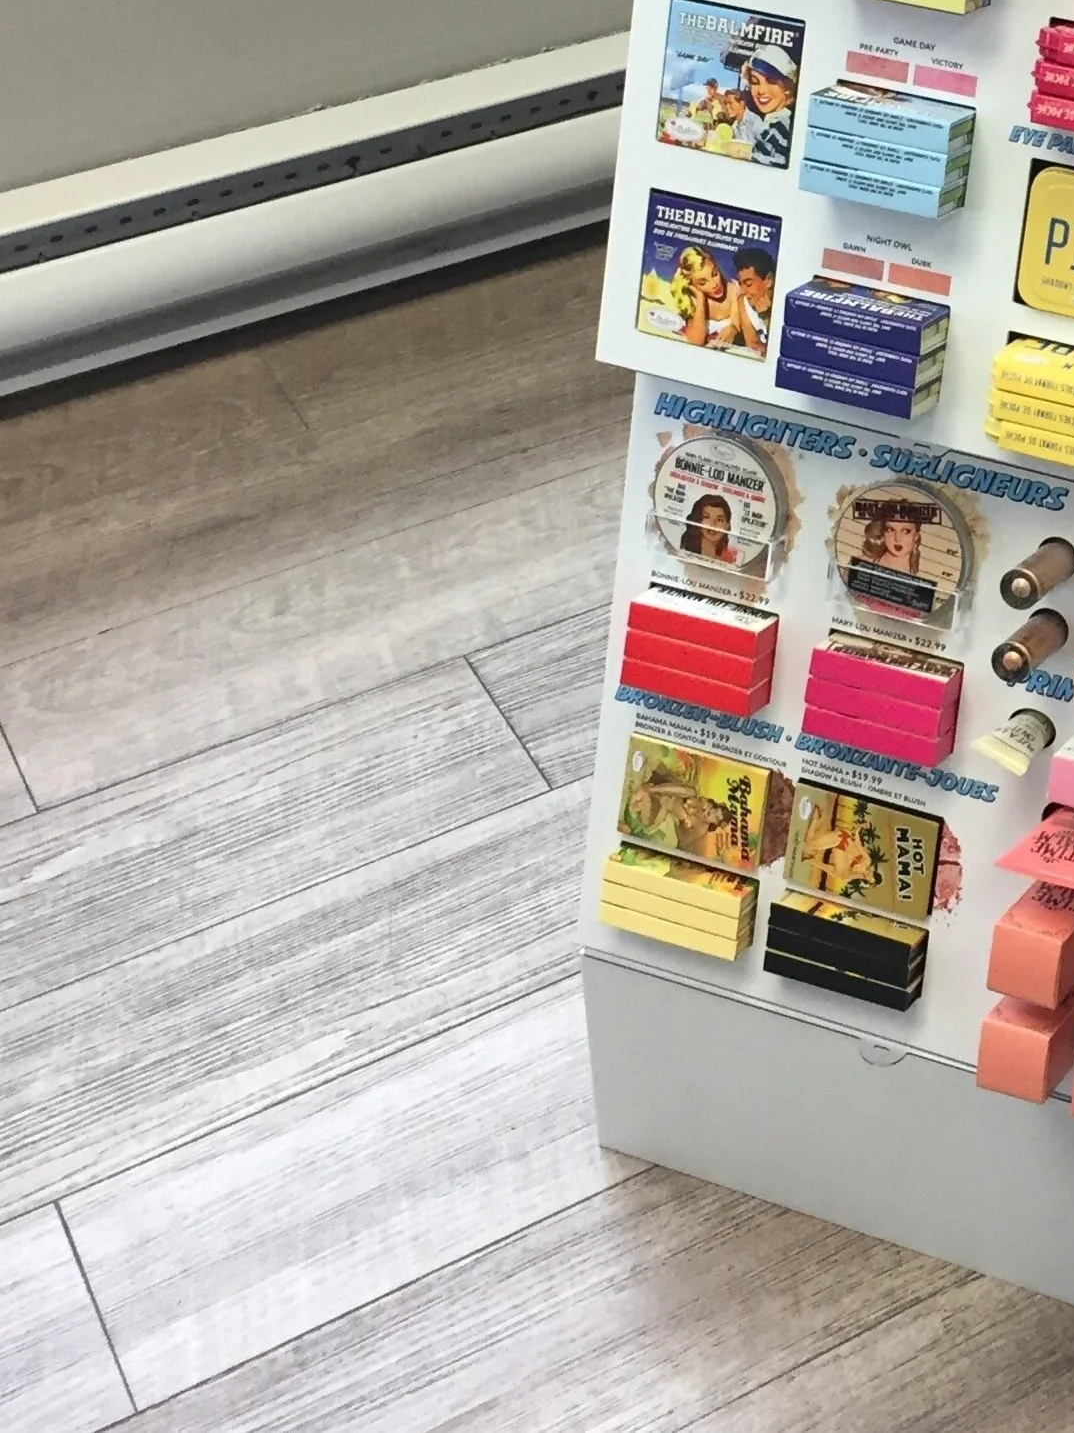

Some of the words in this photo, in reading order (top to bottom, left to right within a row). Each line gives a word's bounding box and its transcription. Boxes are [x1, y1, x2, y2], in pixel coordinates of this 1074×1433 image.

[680, 12, 795, 47] THEBALMFIRE
[859, 43, 899, 56] PRE-PARTY
[893, 36, 917, 48] GAME
[920, 42, 936, 51] DAY
[931, 57, 964, 70] VICTORY
[1009, 125, 1044, 148] EYE
[657, 205, 771, 242] THEBALMFIRE
[843, 242, 866, 253] DAWN
[867, 234, 892, 247] NIGHT
[894, 240, 912, 252] OWL
[912, 257, 932, 268] DUSK
[654, 392, 857, 461] HIGHLIGHTERS
[869, 443, 1069, 512] SURLIGNEURS
[727, 472, 766, 493] MANIZER
[740, 591, 770, 605] $22.99
[914, 636, 946, 651] $22.99
[636, 712, 667, 726] BAHAMA
[669, 720, 692, 733] MAMA
[700, 728, 730, 743] $19.99
[801, 758, 818, 769] HOT
[820, 763, 844, 776] MAMA
[852, 770, 883, 786] $19.99
[739, 775, 752, 861] Bahama
[894, 825, 913, 903] MAMA!
[911, 837, 925, 876] HOT
